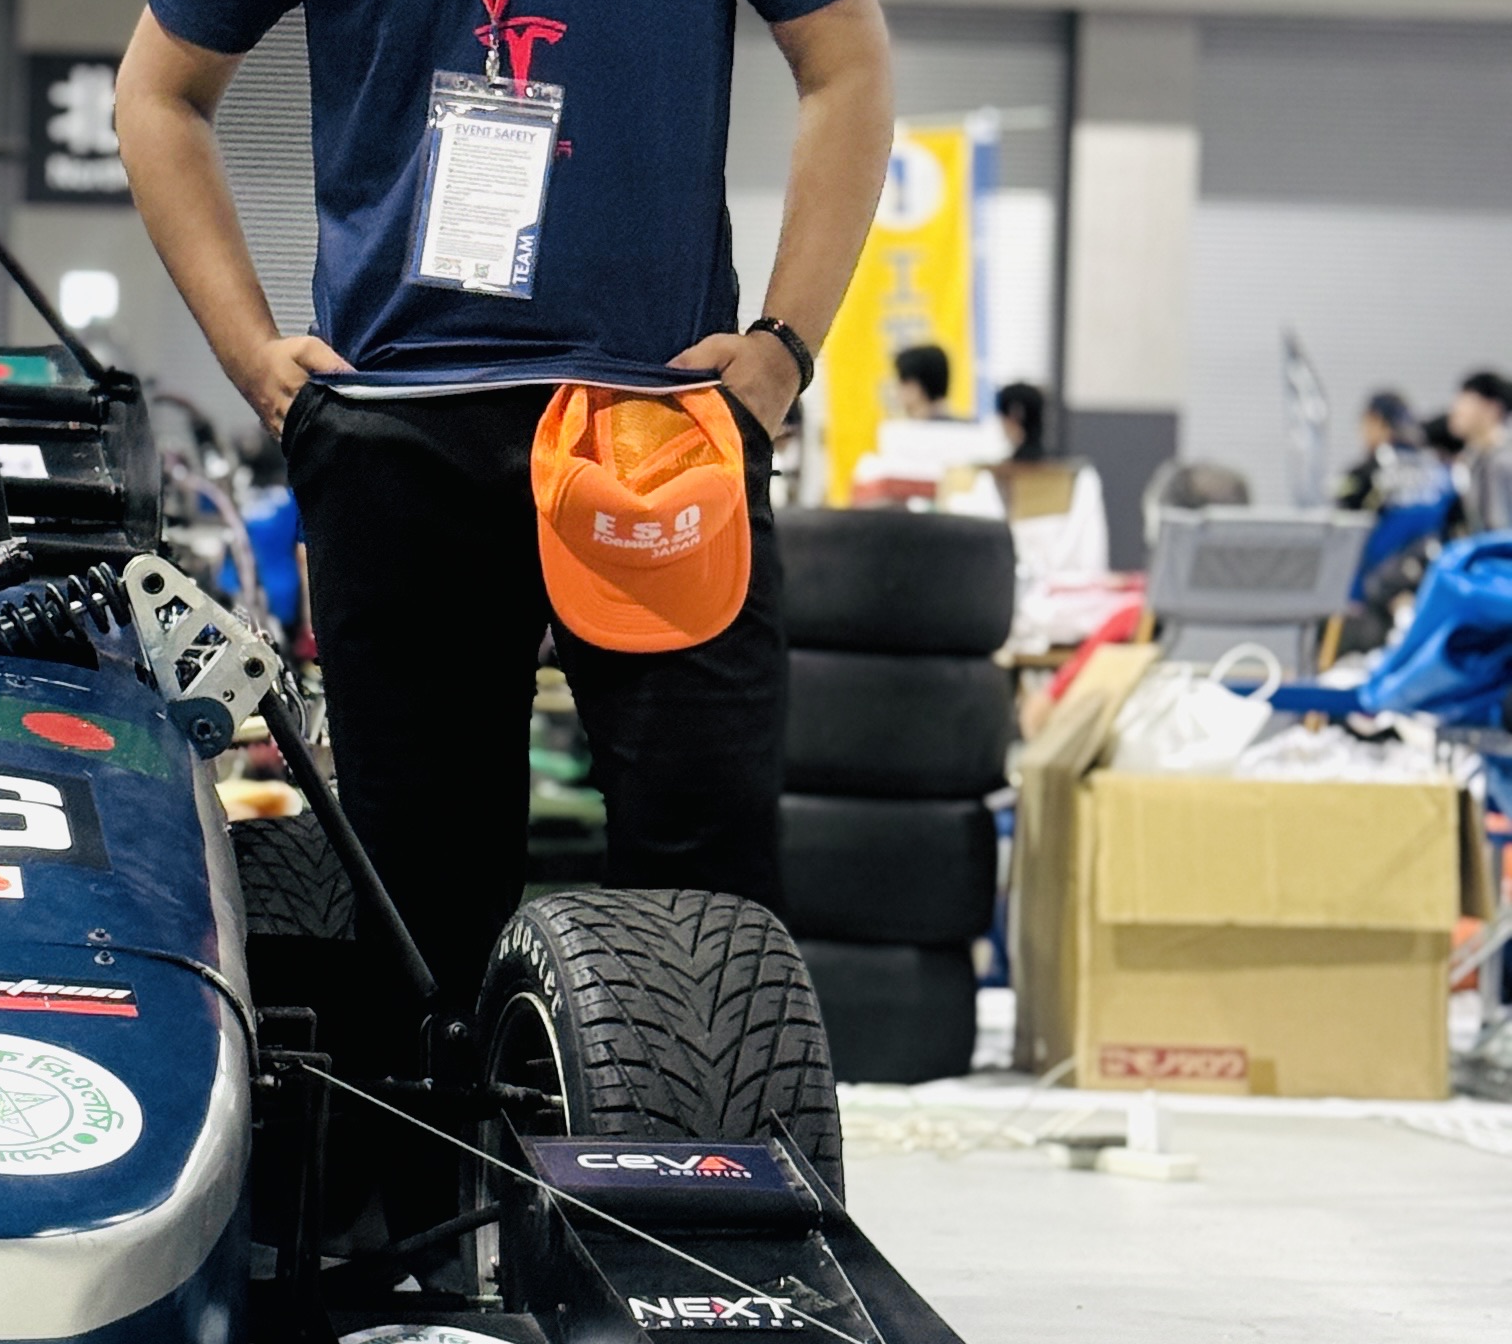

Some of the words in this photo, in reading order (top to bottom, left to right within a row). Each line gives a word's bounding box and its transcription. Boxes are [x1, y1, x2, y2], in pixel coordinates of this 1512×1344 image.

[454, 123, 491, 137] EVENT
[494, 127, 538, 143] SAFETY
[512, 234, 535, 285] TEAM
[593, 531, 670, 549] FORMULA
[651, 534, 701, 559] JAPAN
[627, 1297, 792, 1320] NEXT
